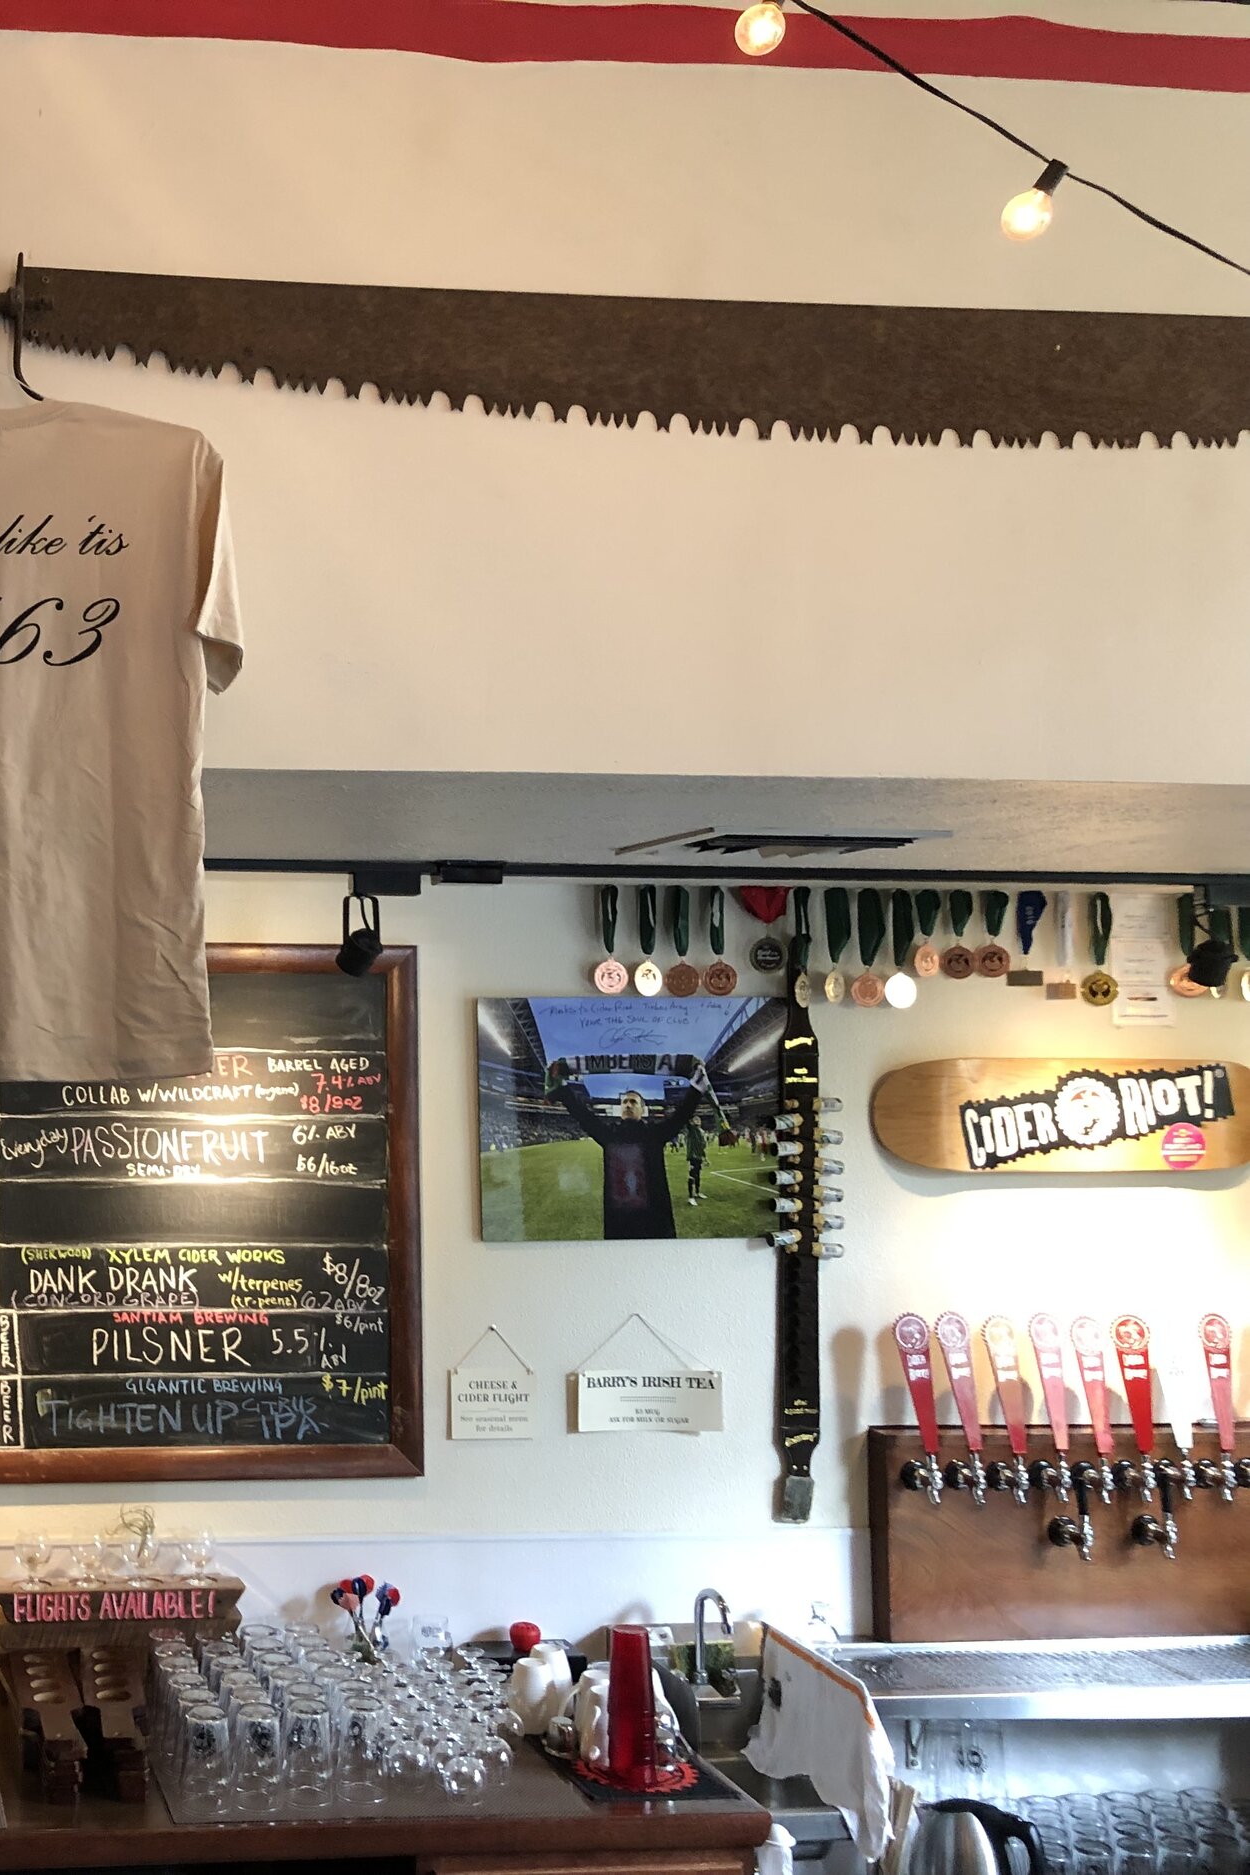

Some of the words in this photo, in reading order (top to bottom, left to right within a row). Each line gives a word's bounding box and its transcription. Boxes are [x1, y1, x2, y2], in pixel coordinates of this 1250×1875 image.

[267, 1056, 323, 1073] BARREL
[330, 1057, 370, 1073] AGED
[62, 1085, 130, 1106] COLLAB
[964, 1102, 1058, 1167] CIDER
[1117, 1070, 1215, 1136] RIOT!
[71, 1123, 269, 1167] PASSIONFRUIT
[326, 1124, 356, 1140] ABV
[106, 1247, 171, 1265] XYLEM
[178, 1248, 222, 1265] CIDER
[226, 1248, 286, 1264] WORKS
[30, 1265, 97, 1294] DANK
[108, 1265, 198, 1297] DRANK
[113, 1312, 183, 1325] SANTIAM
[194, 1312, 270, 1326] BREWING
[92, 1326, 251, 1367] PILSNER
[320, 1344, 347, 1369] ABV
[125, 1378, 207, 1395] GIGANTIC
[213, 1377, 283, 1395] BREWING
[469, 1380, 509, 1390] CHEESE
[511, 1380, 518, 1390] &
[587, 1376, 638, 1388] BARRY'S
[642, 1376, 681, 1388] IRISH
[686, 1377, 716, 1390] TEA
[457, 1393, 490, 1403] CIDER
[492, 1393, 530, 1404] FLIGHT
[43, 1399, 182, 1437] TIGHTEN
[191, 1399, 239, 1434] UP
[14, 1592, 91, 1622] FLIGHTS
